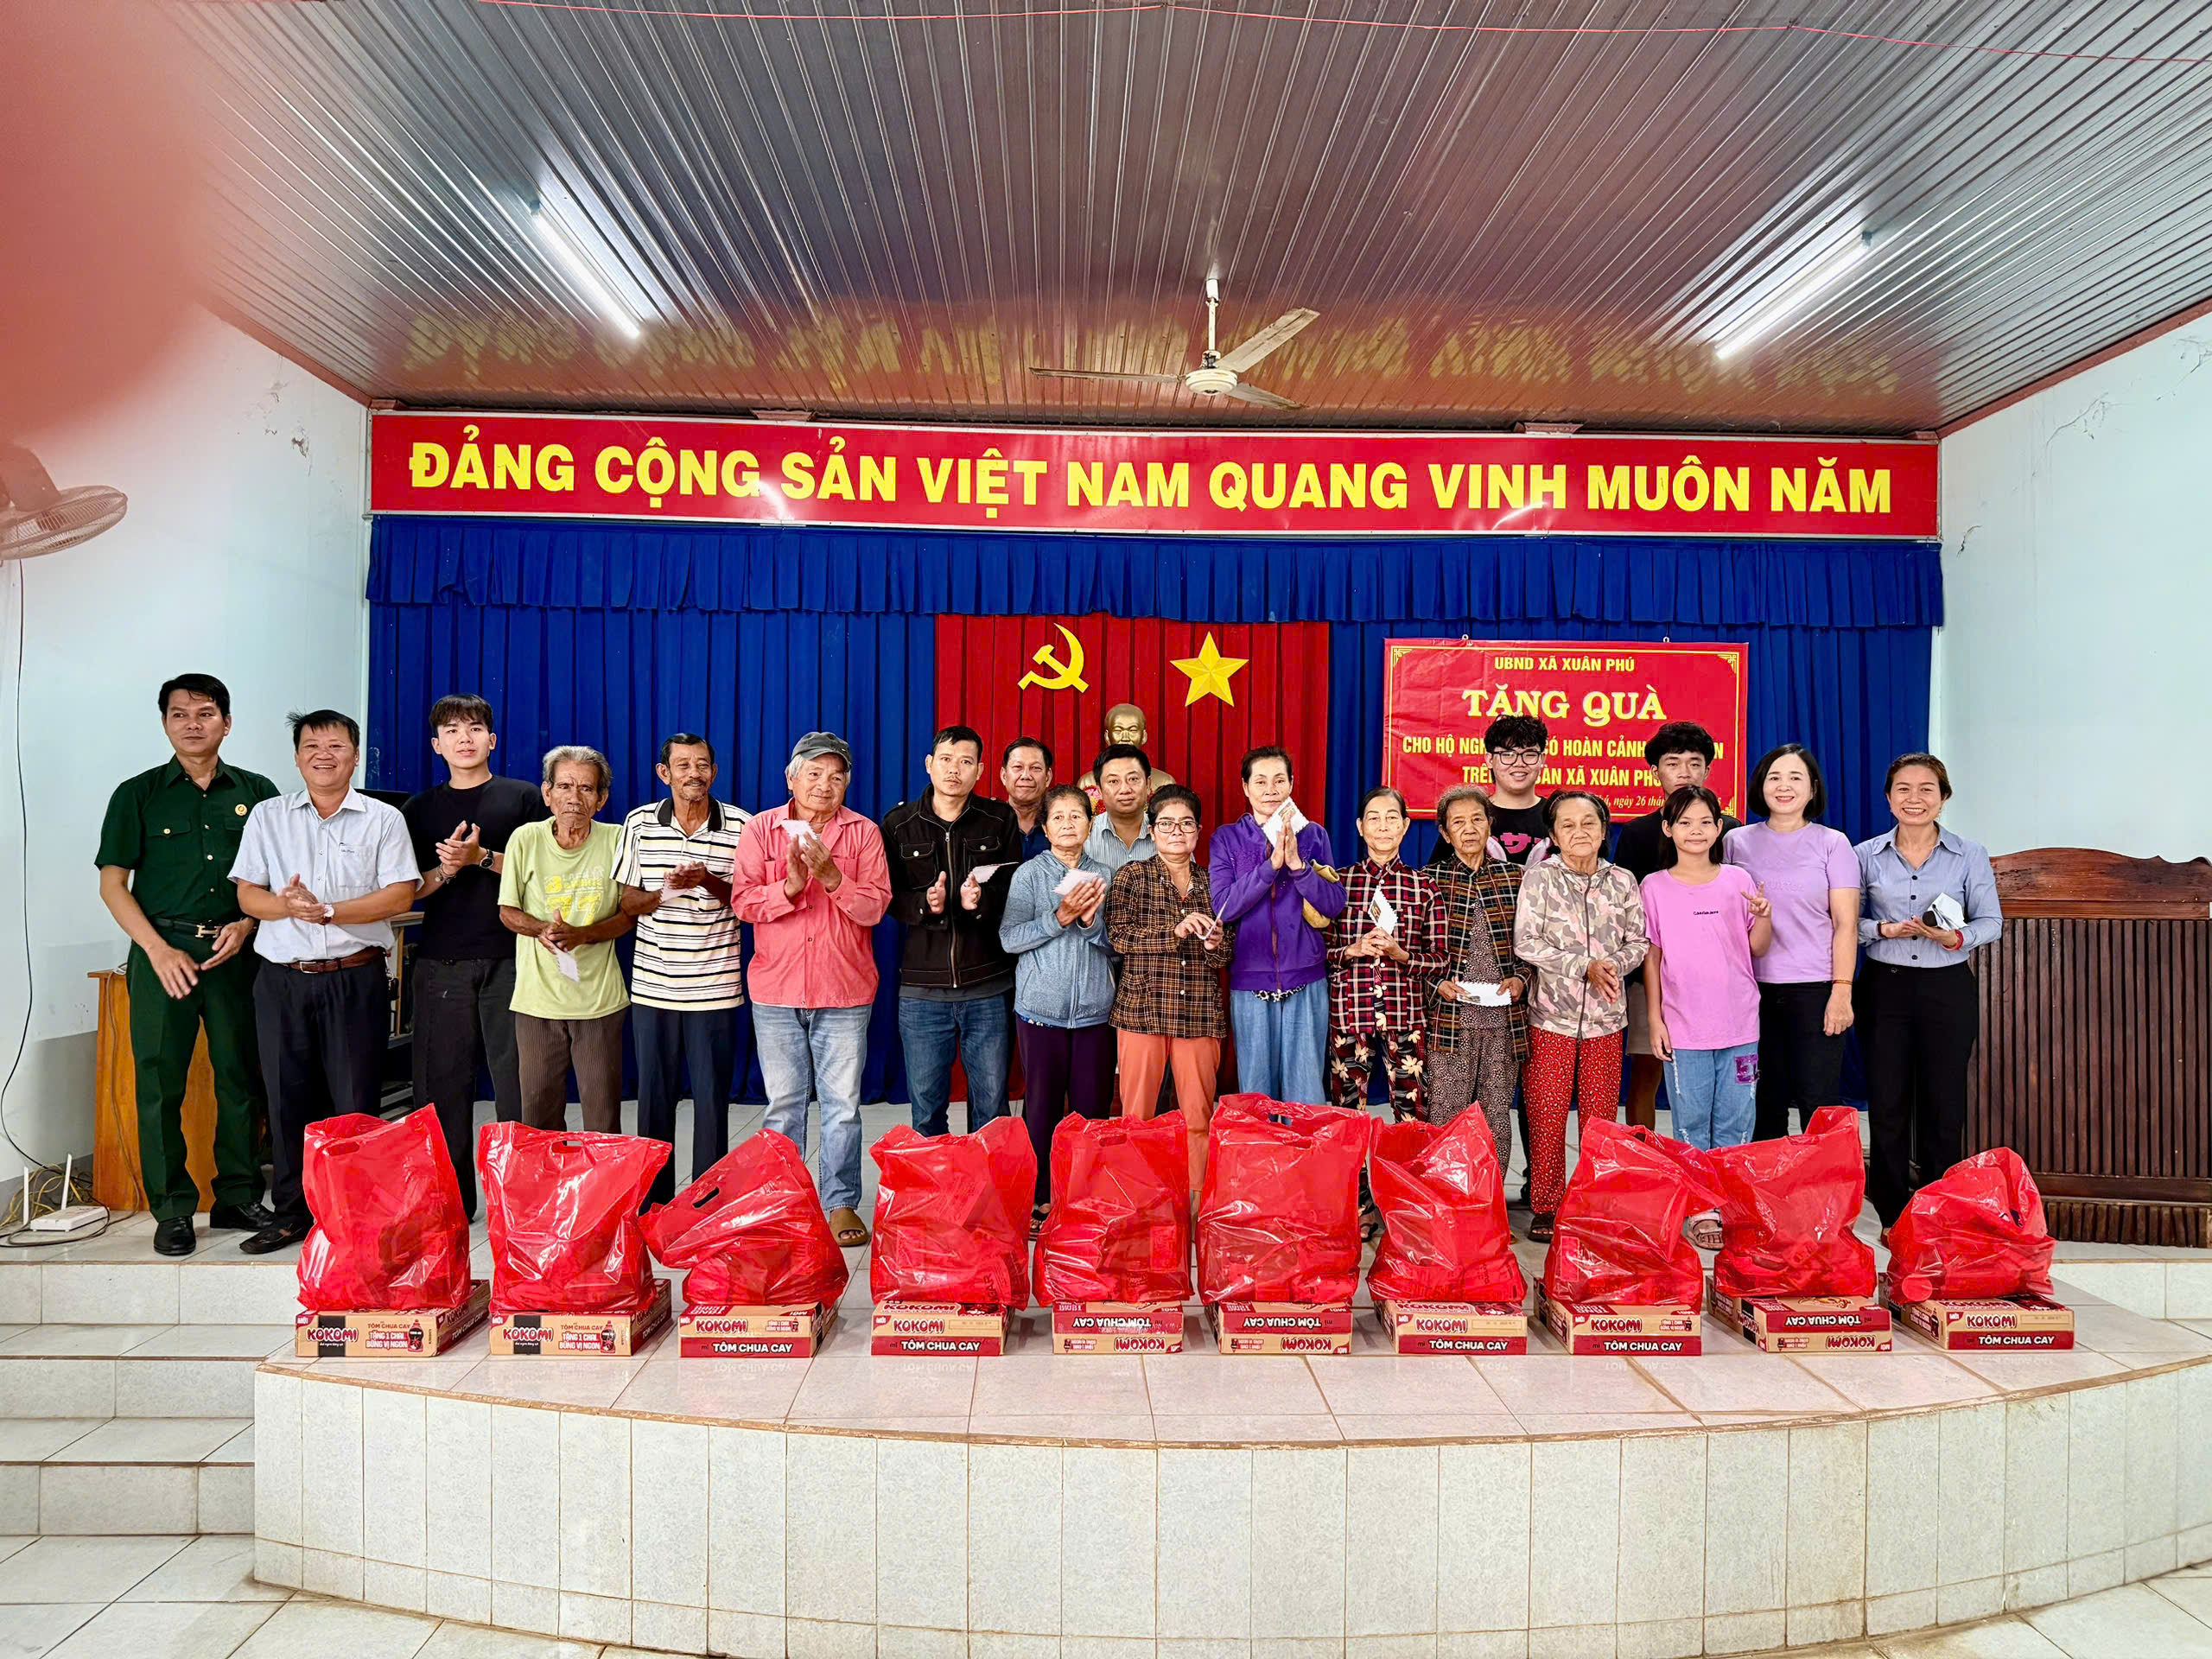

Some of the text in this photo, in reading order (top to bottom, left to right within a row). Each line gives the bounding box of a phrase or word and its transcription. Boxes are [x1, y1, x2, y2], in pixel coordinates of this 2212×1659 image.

[409, 424, 1891, 518] ĐẢNG CỘNG SẢN VIỆT NAM QUANG VINH MUÔN NĂM
[1494, 655, 1635, 672] UBND XÃ XUÂN PHÚ
[1583, 683, 1668, 728] QUÀ
[1402, 736, 1432, 753] CHO
[1436, 734, 1455, 758] HỘ
[1459, 737, 1487, 754] NGH
[1563, 735, 1603, 757] HOÀN
[1607, 734, 1646, 758] CẢNH
[1566, 765, 1586, 785] XÃ
[1590, 766, 1630, 786] XUÂN
[1613, 795, 1634, 809] ngày
[1636, 795, 1646, 806] 26
[695, 1319, 748, 1334] KOKOMI
[893, 1319, 944, 1334] KOKOMI
[1072, 1317, 1095, 1328] CAY
[1096, 1317, 1125, 1327] CHUA
[1126, 1317, 1152, 1329] TÔM
[1243, 1317, 1264, 1327] CAY
[1267, 1317, 1296, 1327] CHUA
[1297, 1317, 1322, 1329] TÔM
[1415, 1319, 1468, 1334] KOKOMI
[1590, 1318, 1642, 1333] KOKOMI
[1785, 1316, 1806, 1326] CAY
[1808, 1315, 1837, 1326] CHUA
[1838, 1315, 1862, 1327] TÔM
[1966, 1314, 2018, 1329] KOKOMI
[306, 1327, 359, 1342] KOKOMI
[503, 1327, 554, 1342] KOKOMI
[1978, 1333, 2002, 1345] TÔM
[2003, 1336, 2032, 1345] CHUA
[2033, 1336, 2055, 1345] CAY
[712, 1340, 737, 1353] TÔM
[738, 1343, 769, 1354] CHUA
[770, 1343, 793, 1354] CAY
[901, 1339, 925, 1351] TÔM
[926, 1341, 957, 1352] CHUA
[958, 1342, 981, 1352] CAY
[1114, 1337, 1166, 1351] KOKOMI
[1281, 1337, 1332, 1352] KOKOMI
[1429, 1338, 1453, 1351] TÔM
[1454, 1340, 1484, 1351] CHUA
[1486, 1341, 1509, 1351] CAY
[1604, 1339, 1628, 1351] TÔM
[1630, 1342, 1659, 1351] CHUA
[1661, 1342, 1683, 1352] CAY
[1826, 1335, 1877, 1350] KOKOMI
